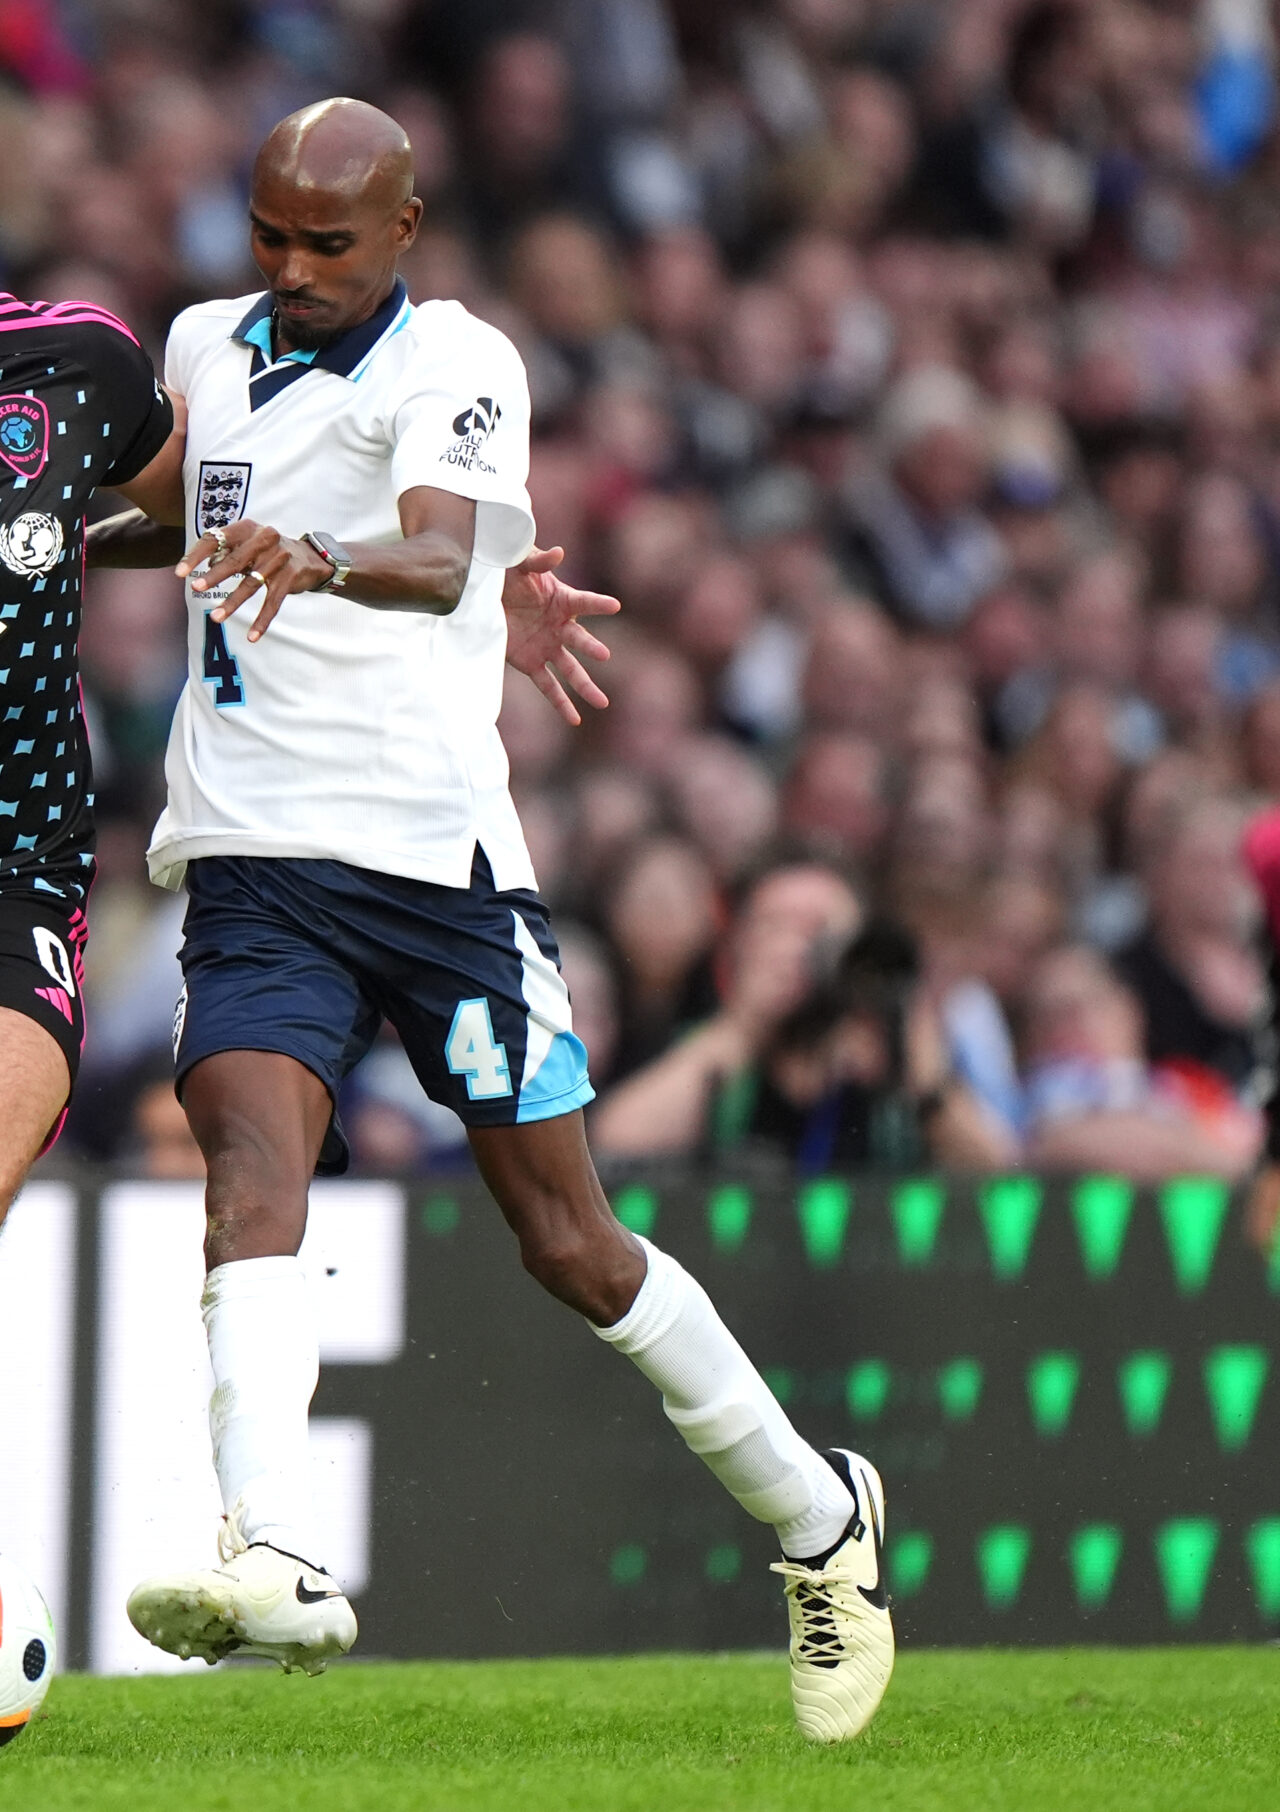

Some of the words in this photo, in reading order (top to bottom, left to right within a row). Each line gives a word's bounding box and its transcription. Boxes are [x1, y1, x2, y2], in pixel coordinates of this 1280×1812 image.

[21, 405, 41, 421] AID
[202, 609, 246, 708] 4
[443, 996, 514, 1101] 4
